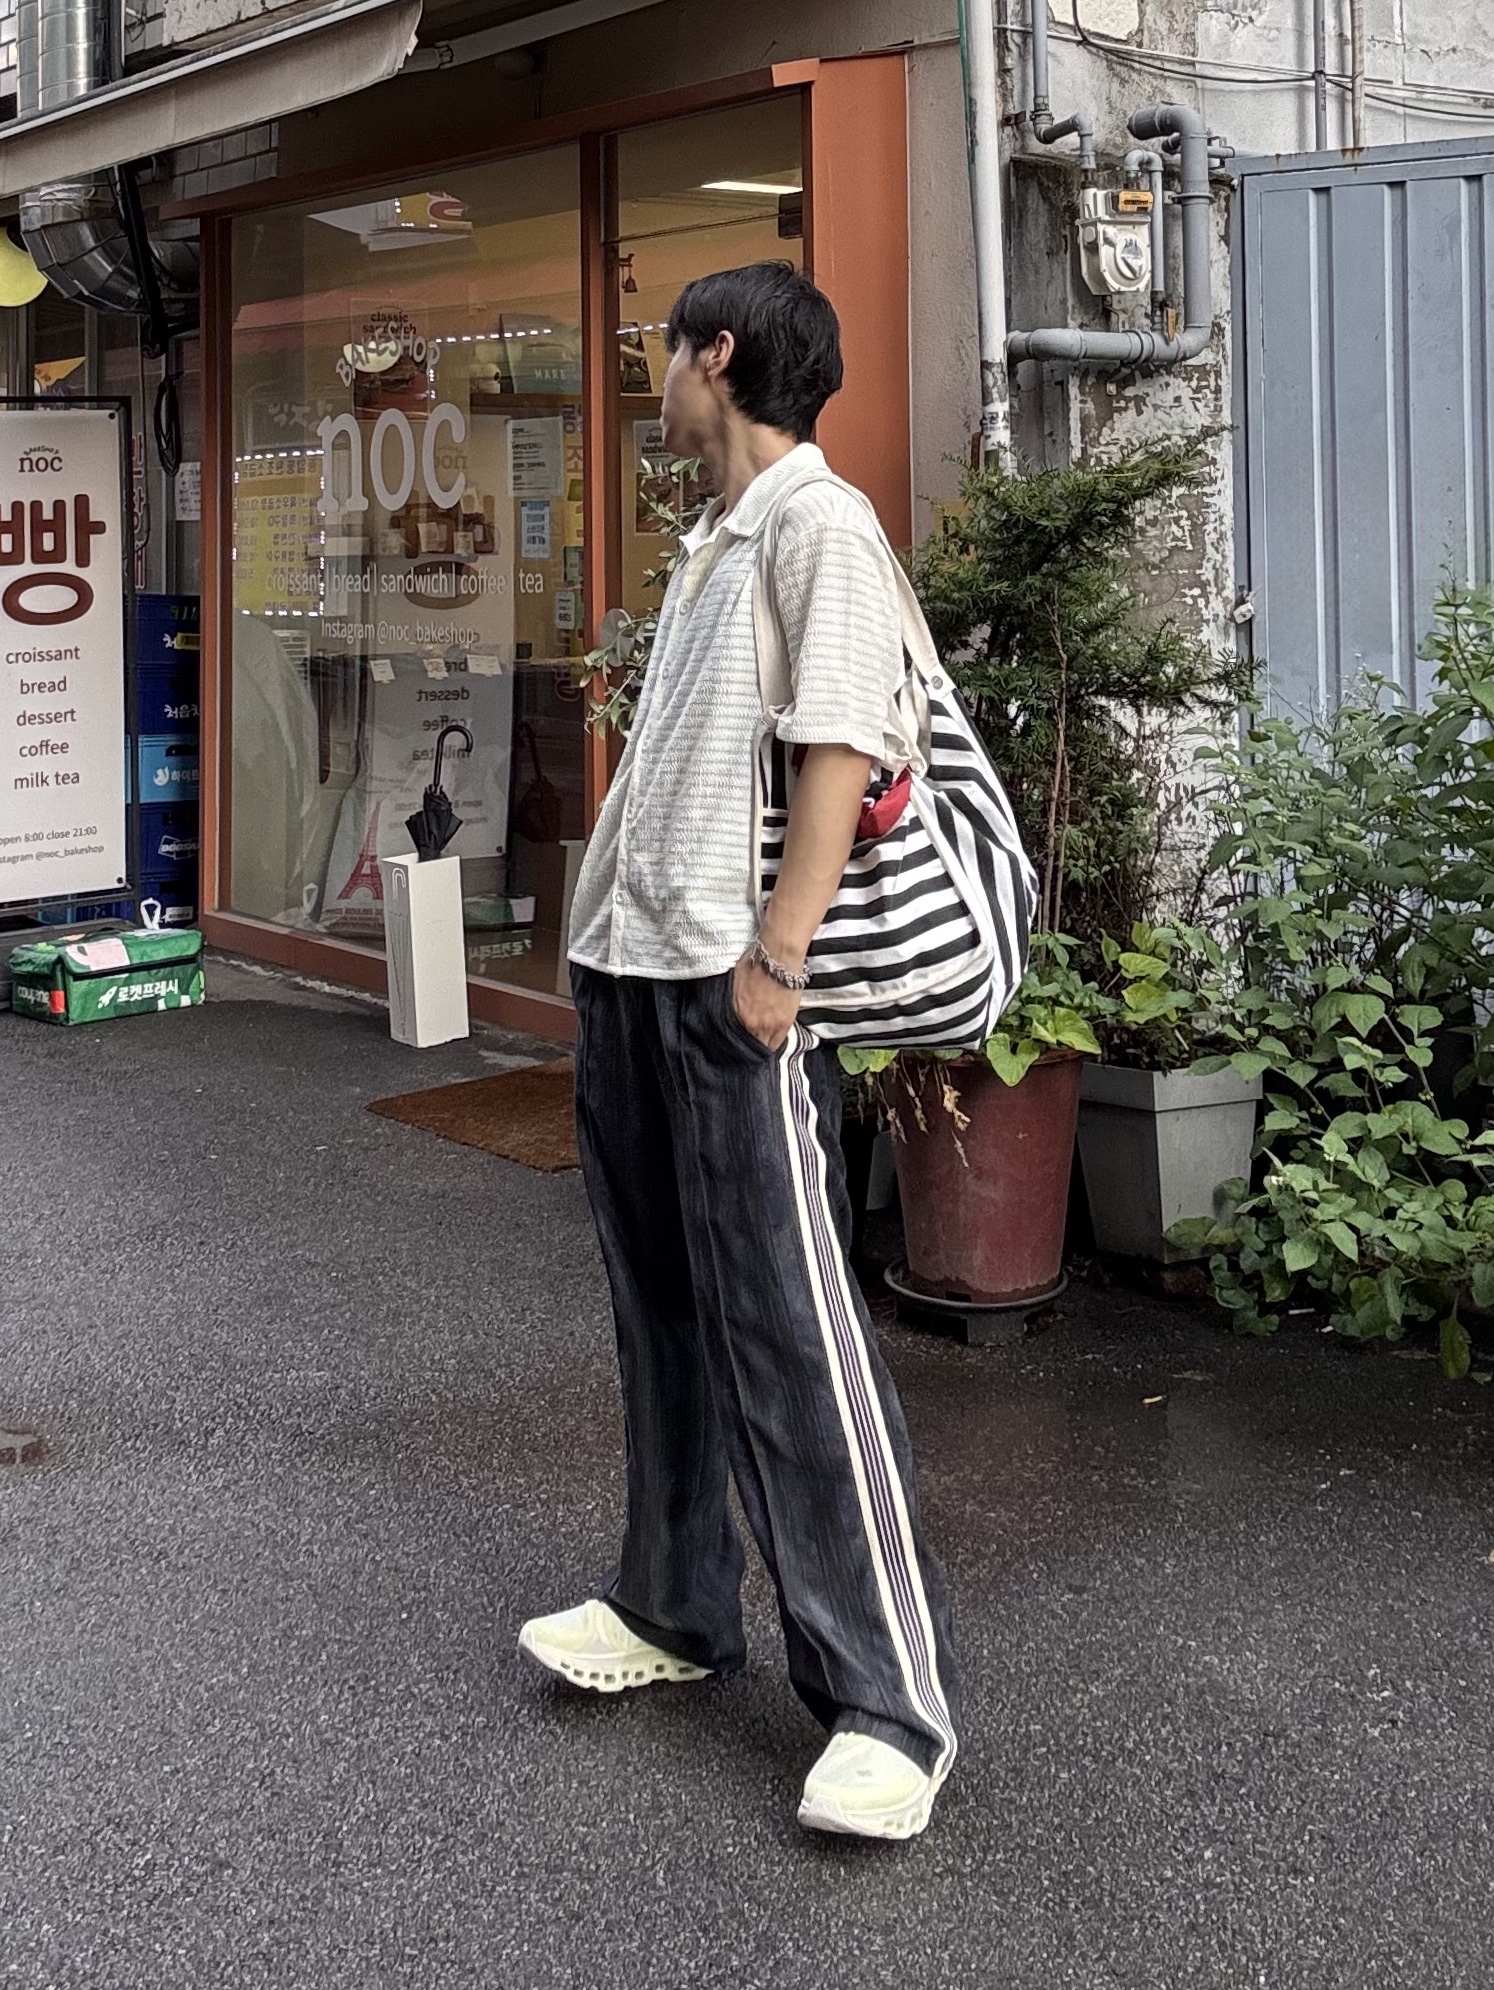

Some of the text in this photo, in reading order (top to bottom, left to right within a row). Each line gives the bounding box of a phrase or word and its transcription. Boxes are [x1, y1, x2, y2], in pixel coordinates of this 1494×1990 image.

[336, 321, 440, 387] BAKESHOP
[18, 456, 63, 473] noc
[317, 403, 466, 511] noc
[0, 494, 106, 625] 빵
[266, 566, 544, 595] croissant bread sandwich coffee tea
[321, 619, 474, 649] Instagram @noc_bakeshop
[5, 645, 80, 664] croissant
[20, 675, 67, 695] bread
[16, 708, 77, 727] dessert
[19, 739, 70, 757] coffee
[14, 770, 80, 790] milk tea
[46, 829, 70, 841] close
[117, 979, 179, 1003] 로켓프레시
